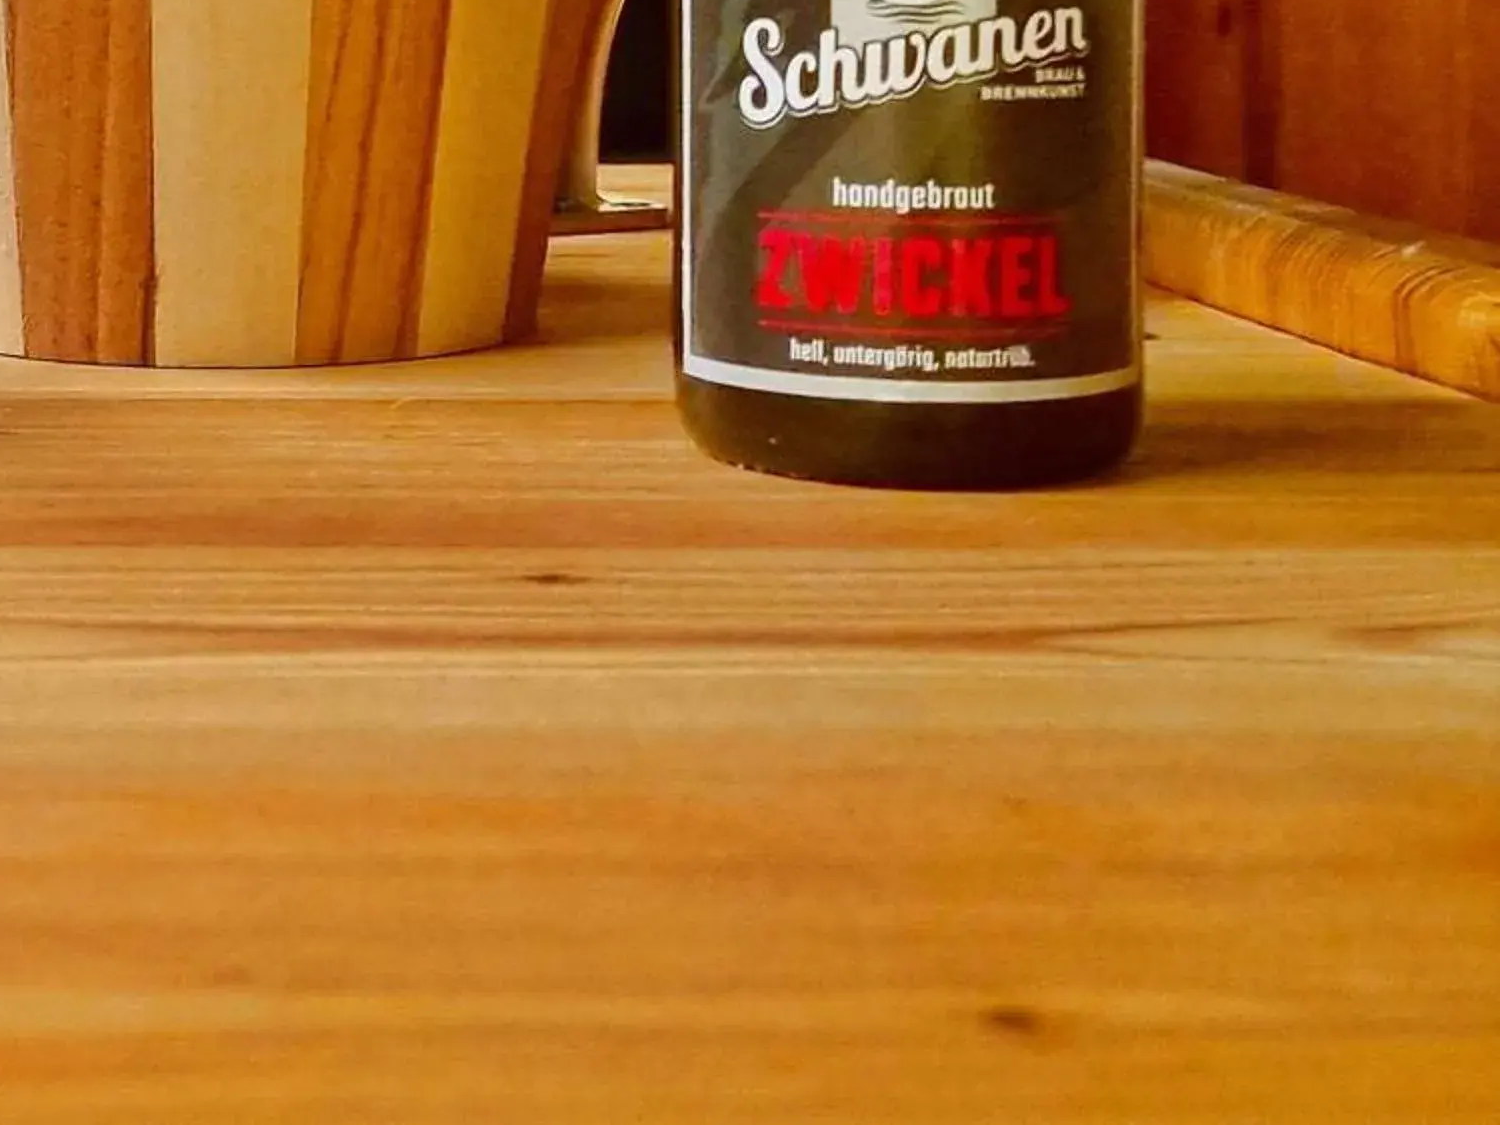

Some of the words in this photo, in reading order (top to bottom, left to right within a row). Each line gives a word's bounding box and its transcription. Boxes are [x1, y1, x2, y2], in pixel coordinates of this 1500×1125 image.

[738, 4, 1089, 129] Schwanen
[832, 177, 996, 214] handgebraut
[756, 229, 1073, 317] ZWICKEL
[789, 336, 829, 366] hell,
